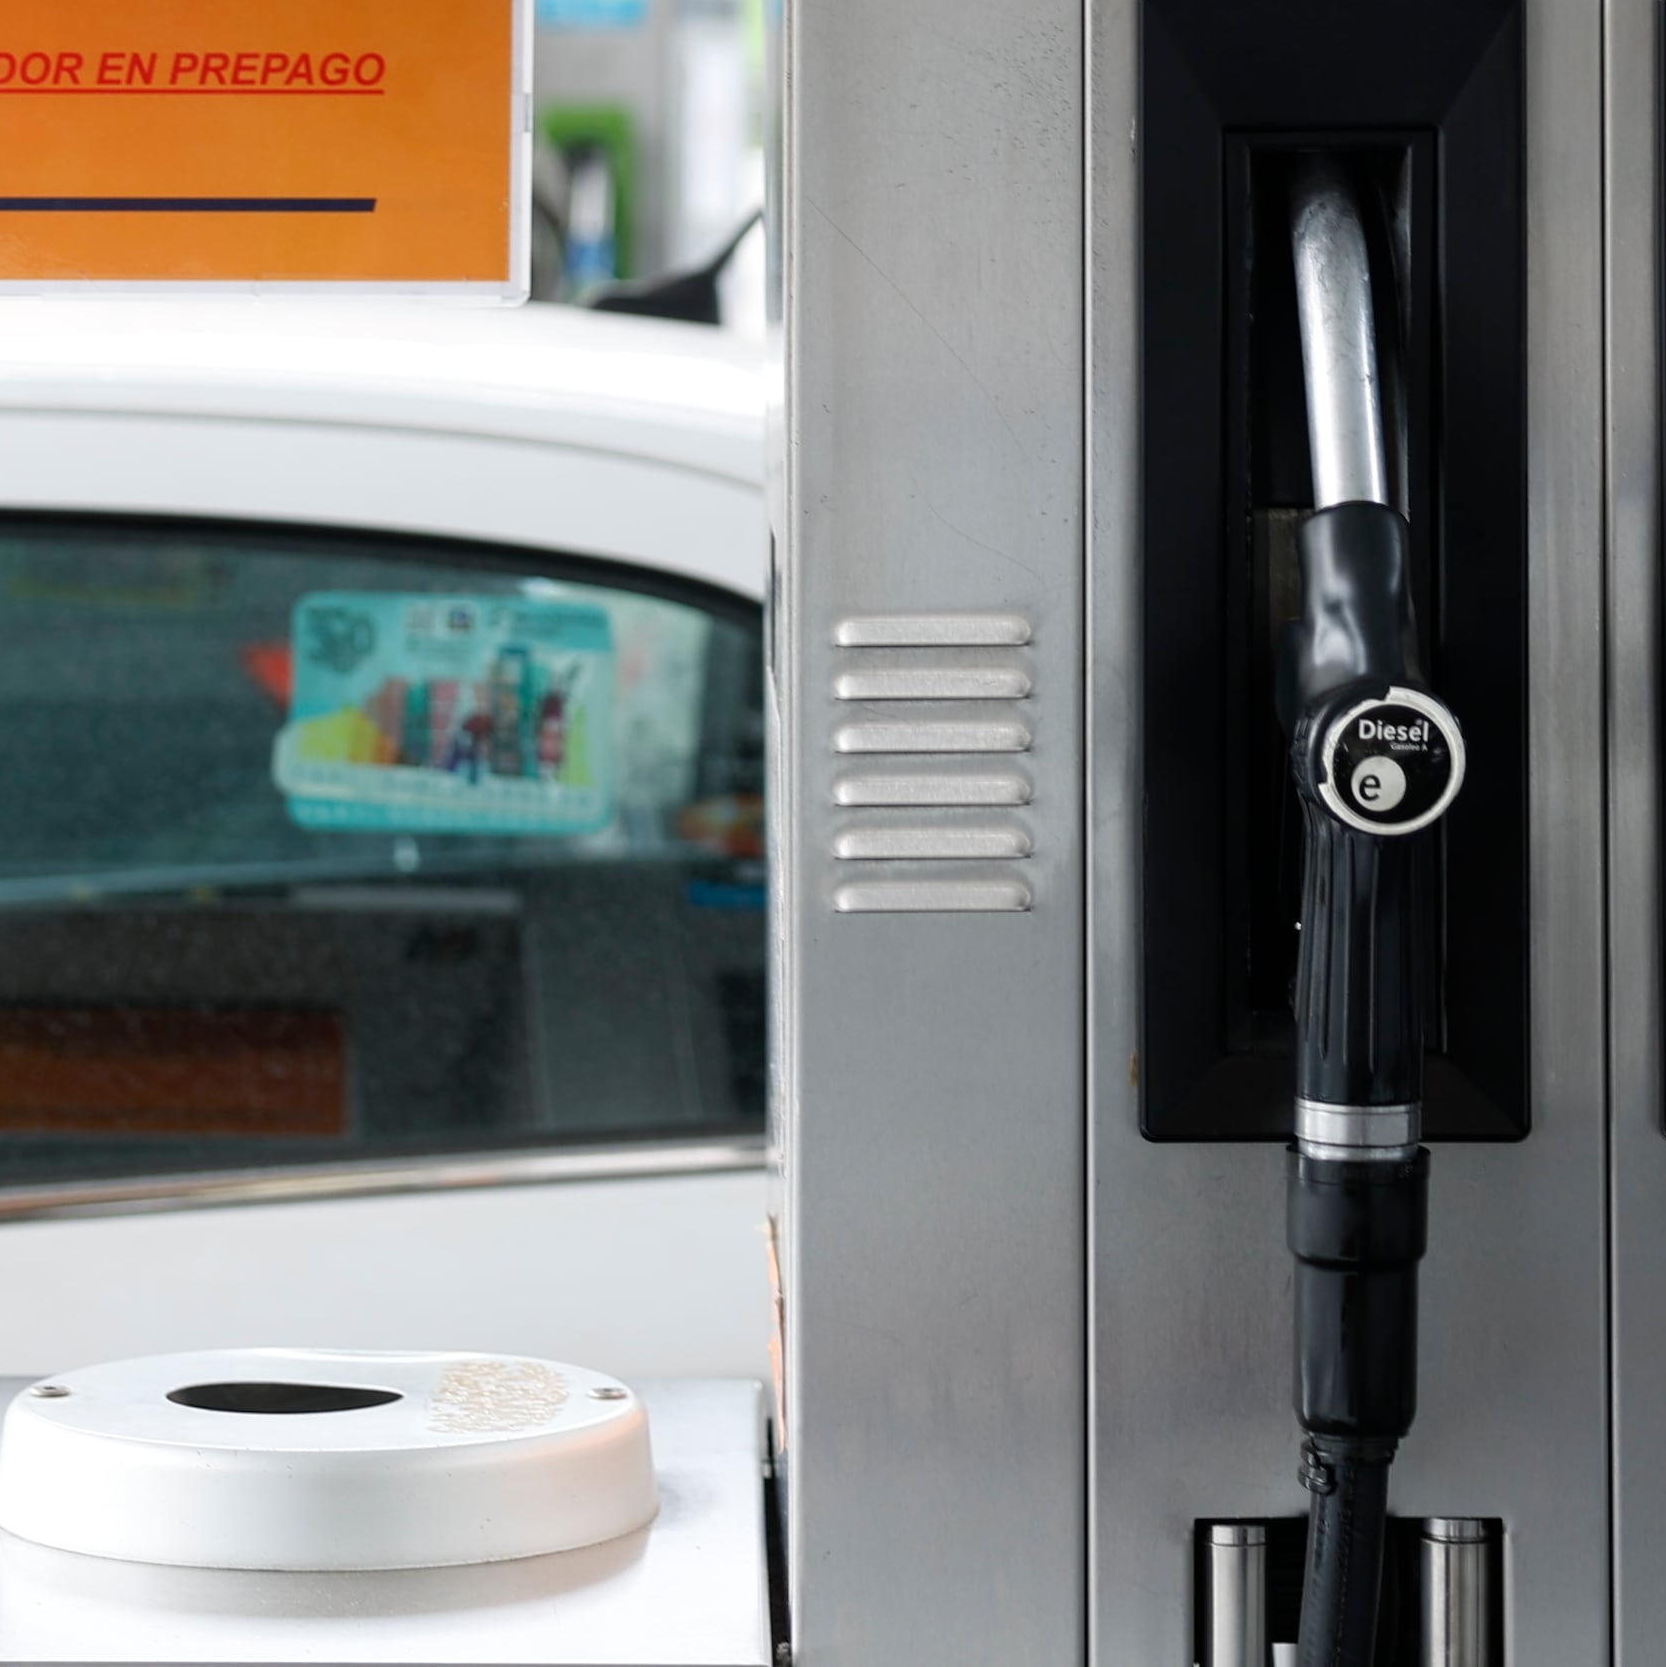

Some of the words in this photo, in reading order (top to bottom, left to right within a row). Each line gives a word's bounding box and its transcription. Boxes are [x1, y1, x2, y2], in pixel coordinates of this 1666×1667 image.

[96, 52, 155, 87] EN
[170, 50, 386, 88] PREPAGO
[1359, 719, 1429, 742] Diesel
[1359, 774, 1381, 801] e
